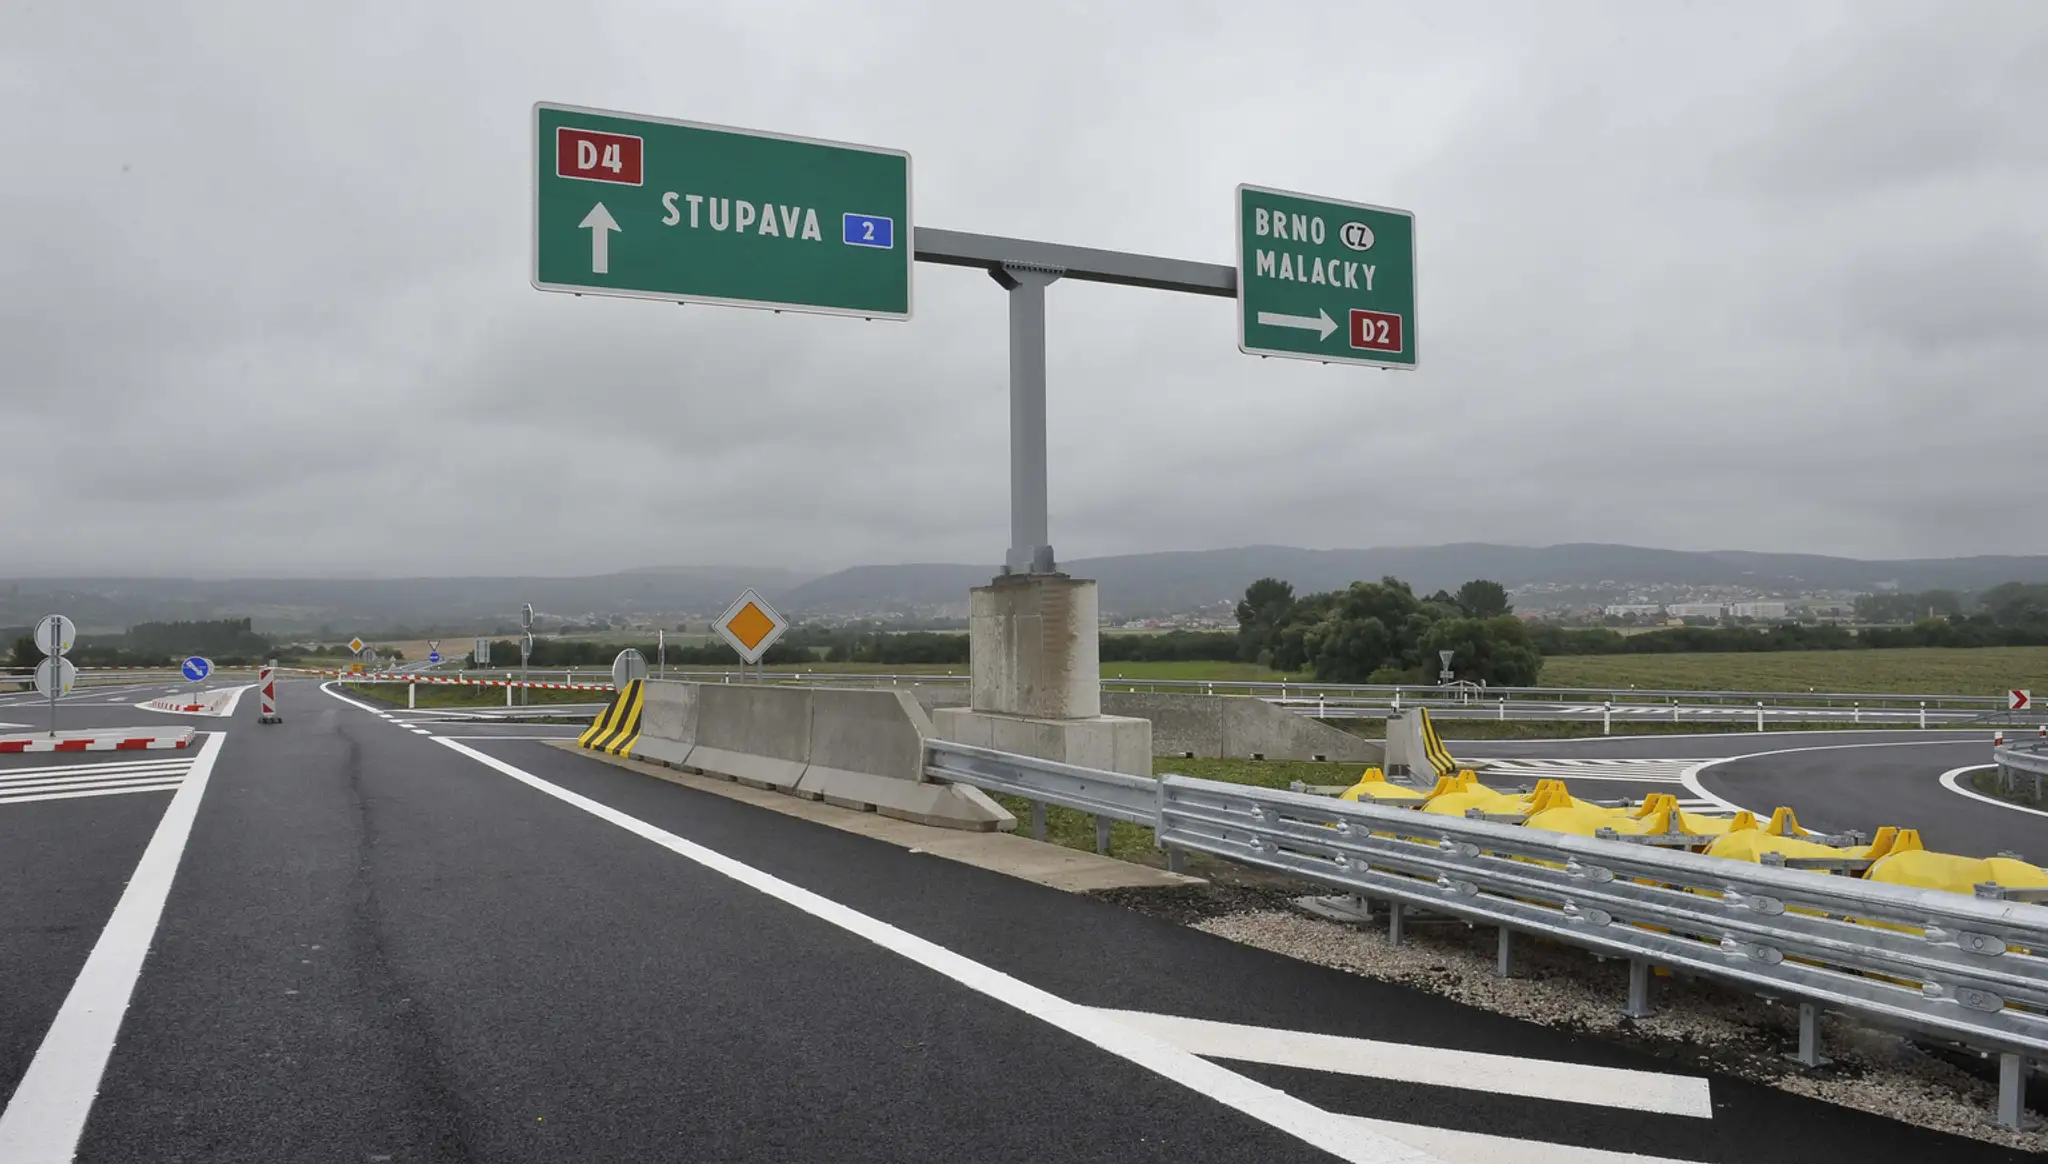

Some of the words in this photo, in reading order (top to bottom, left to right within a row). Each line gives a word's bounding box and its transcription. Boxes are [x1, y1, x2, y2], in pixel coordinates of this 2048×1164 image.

[577, 139, 623, 174] D4
[661, 191, 822, 241] STUPAVA
[862, 221, 875, 241] 2
[1255, 207, 1326, 245] BRNO
[1345, 225, 1367, 247] CZ
[1256, 249, 1376, 291] MALACKY
[1362, 318, 1390, 344] D2
